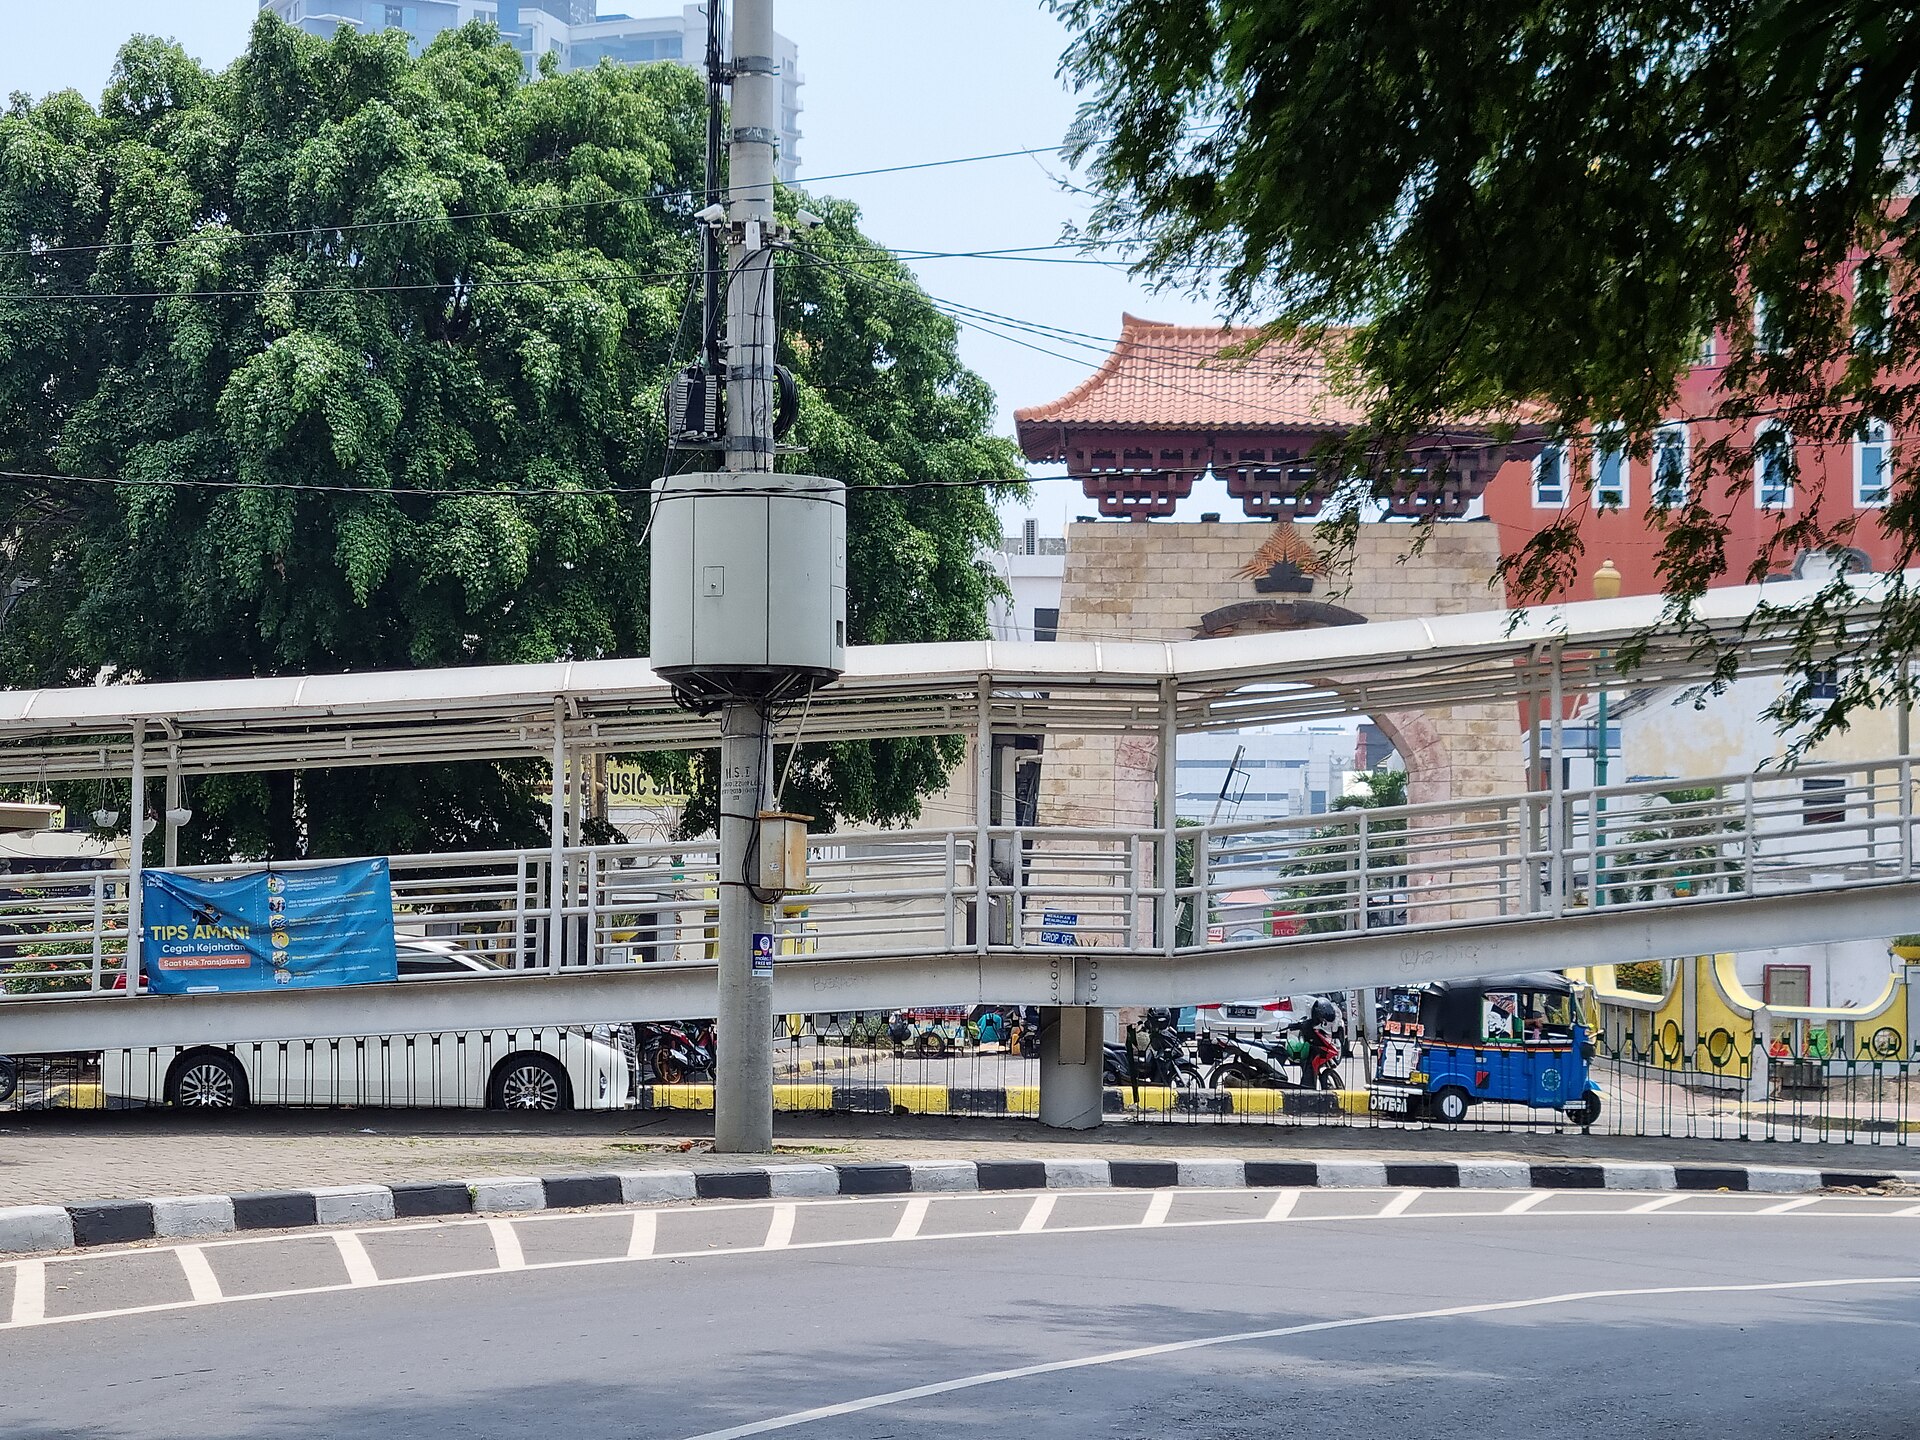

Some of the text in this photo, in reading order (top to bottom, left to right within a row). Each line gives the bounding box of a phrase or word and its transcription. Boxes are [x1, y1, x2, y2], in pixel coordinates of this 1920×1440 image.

[609, 772, 647, 795] USIC
[151, 924, 250, 941] TIPS AMAN!
[1042, 932, 1074, 944] DROP OFF
[162, 941, 246, 955] Cegah Kejahatan
[163, 957, 246, 968] Saat Naik Transjakarta
